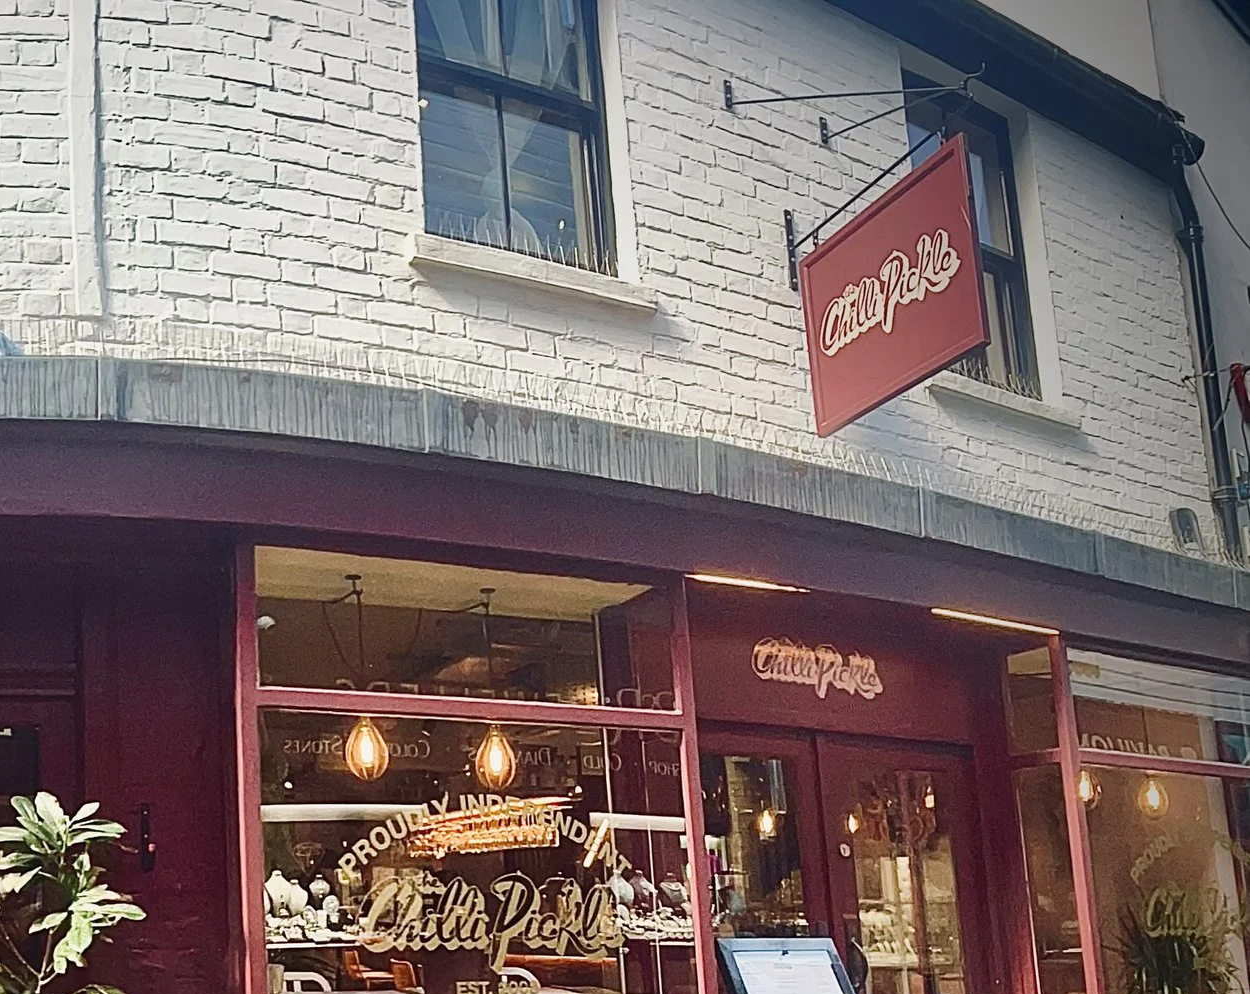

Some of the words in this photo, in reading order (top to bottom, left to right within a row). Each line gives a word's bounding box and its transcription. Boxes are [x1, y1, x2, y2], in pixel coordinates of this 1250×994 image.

[820, 277, 883, 357] Chilli
[880, 229, 961, 333] Pickle
[752, 637, 816, 684] Chilli
[815, 644, 884, 699] Pickle
[338, 793, 449, 876] PROUDLY
[355, 876, 490, 953] Chilli
